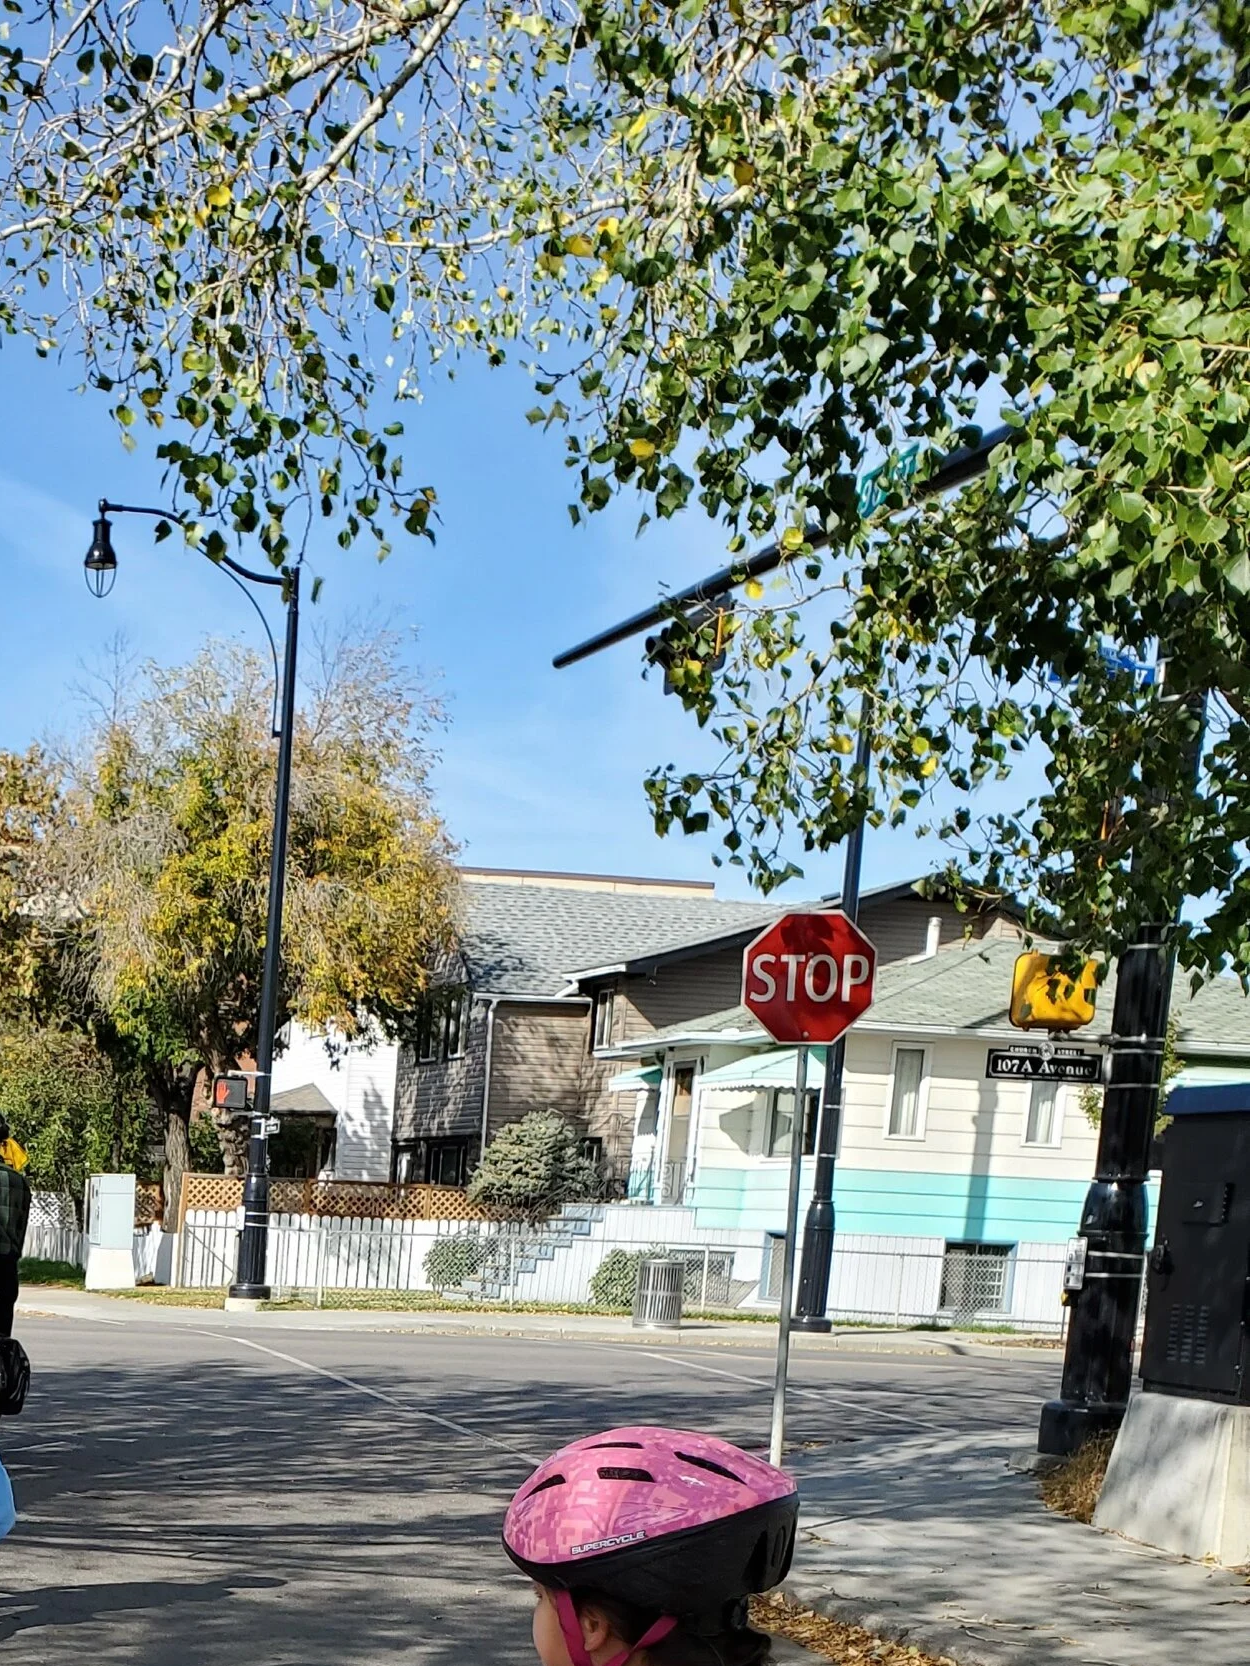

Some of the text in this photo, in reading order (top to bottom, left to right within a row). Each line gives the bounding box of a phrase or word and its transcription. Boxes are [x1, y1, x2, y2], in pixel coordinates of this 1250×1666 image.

[750, 953, 869, 1002] STOP
[996, 1059, 1092, 1075] 107A Avenue
[571, 1530, 645, 1554] SUPERCYCLE
